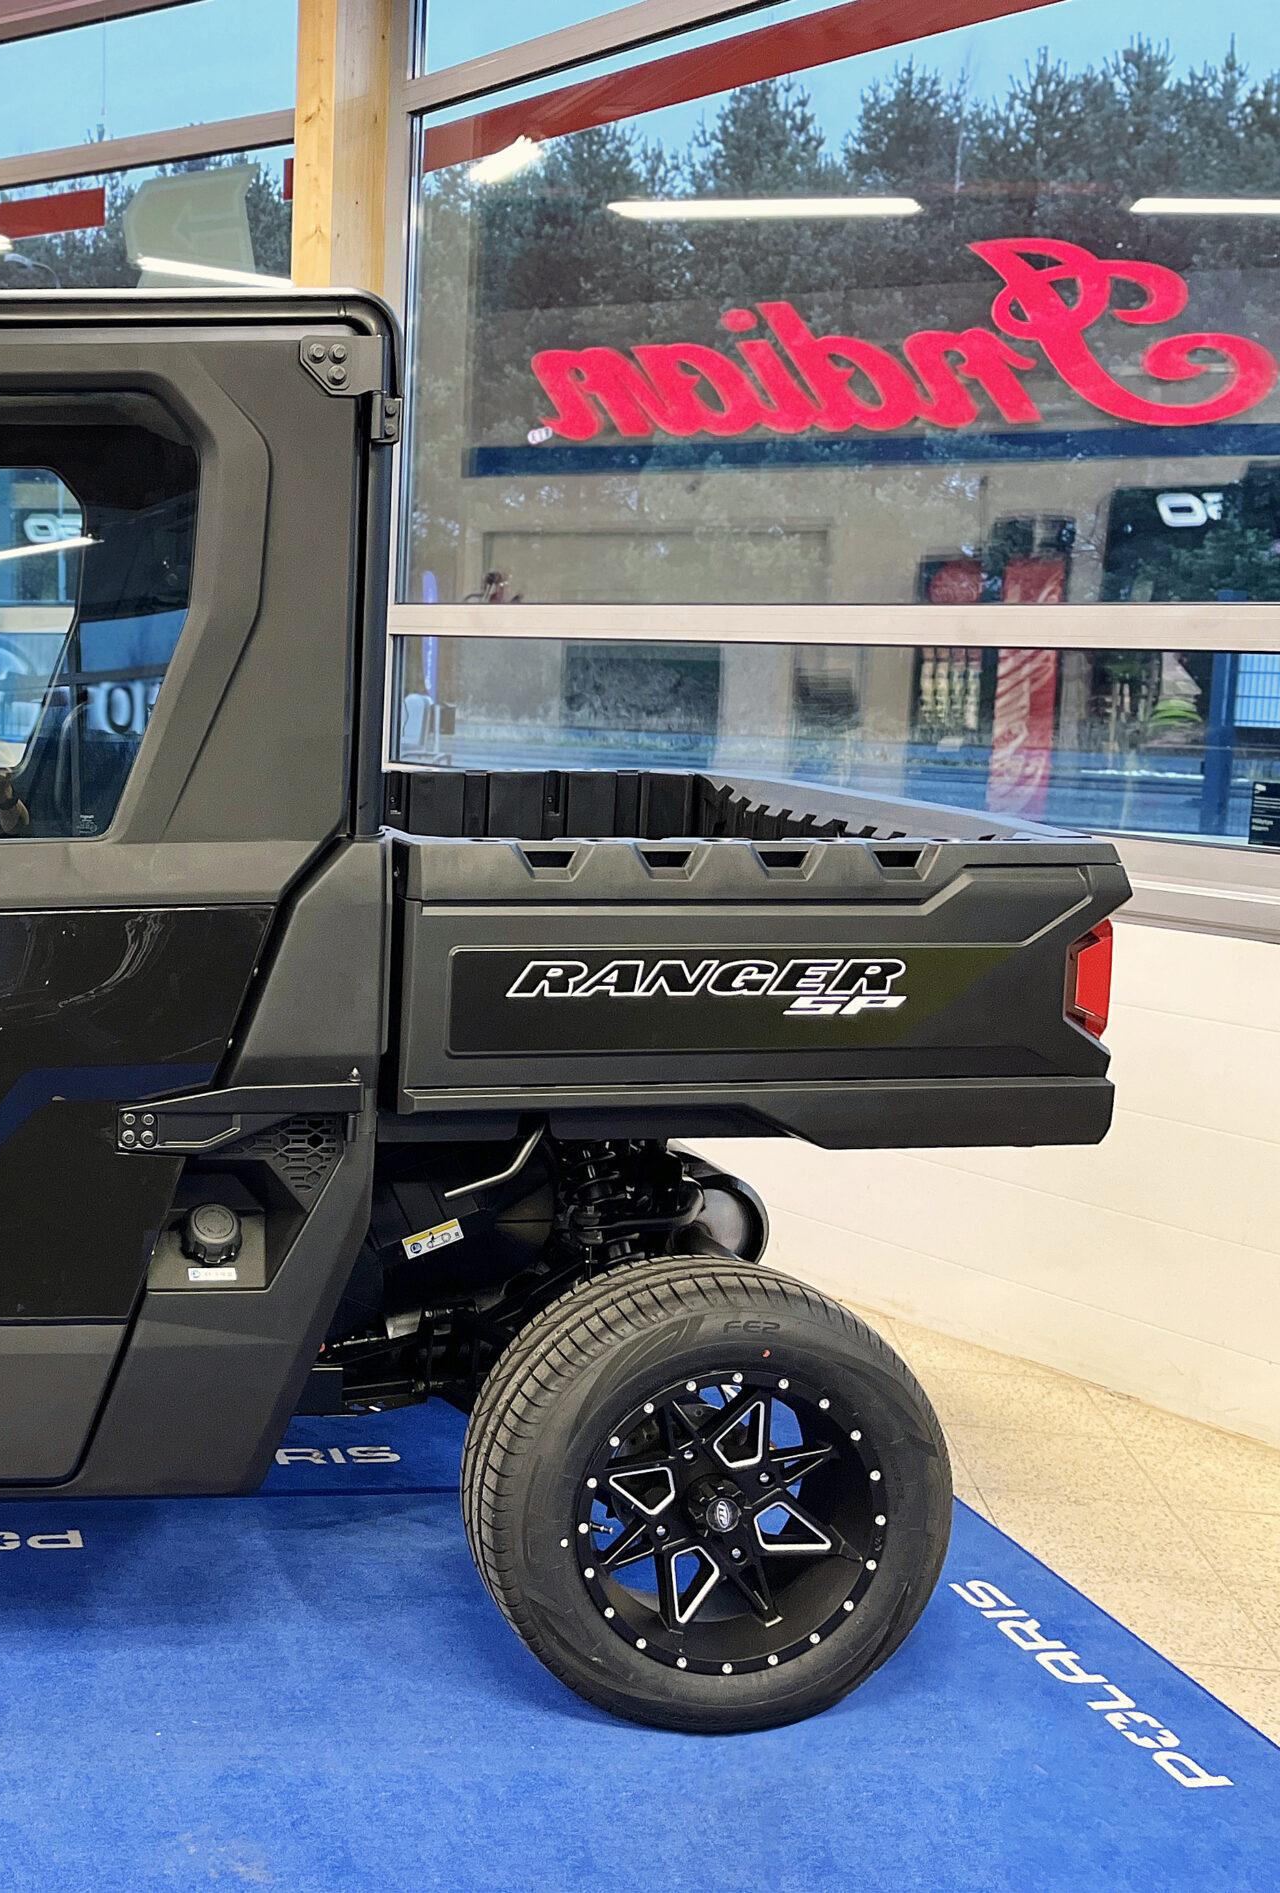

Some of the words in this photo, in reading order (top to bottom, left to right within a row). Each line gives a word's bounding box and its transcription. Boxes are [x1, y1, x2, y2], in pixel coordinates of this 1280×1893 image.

[506, 958, 906, 998] RANGER
[782, 996, 907, 1016] SP
[723, 1320, 780, 1334] FE2
[274, 1446, 401, 1465] RIS
[948, 1579, 1234, 1788] POLARIS
